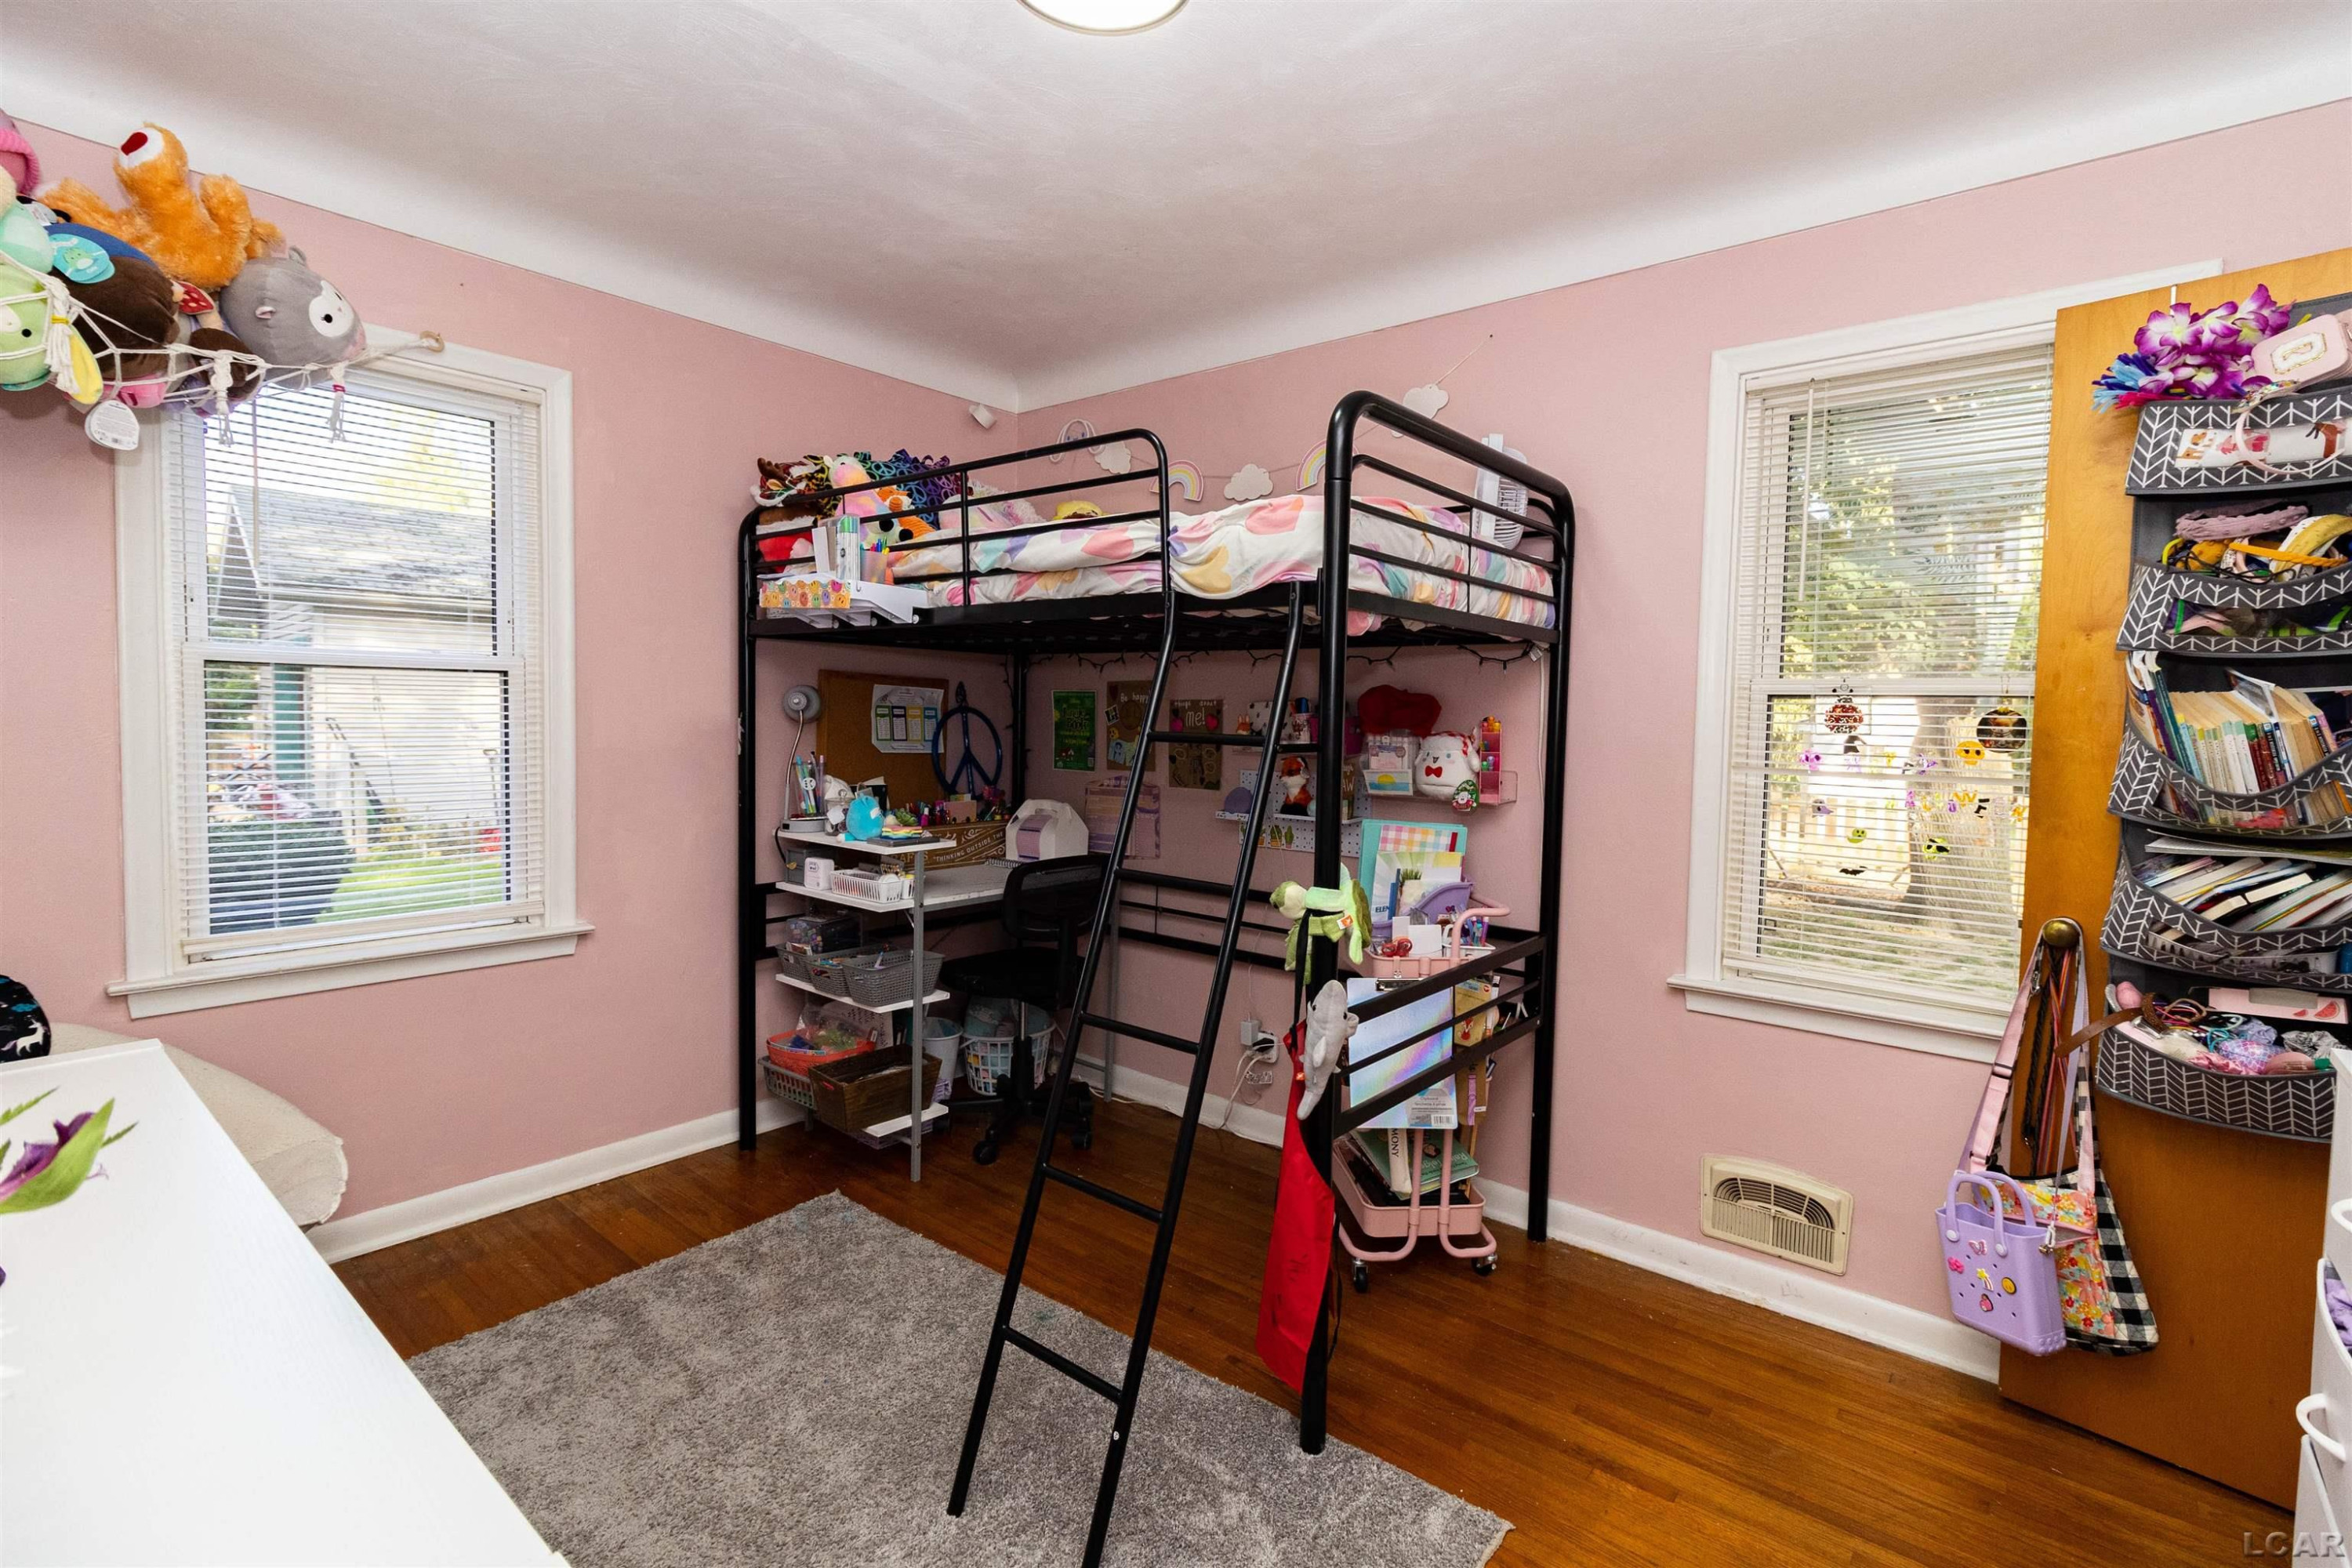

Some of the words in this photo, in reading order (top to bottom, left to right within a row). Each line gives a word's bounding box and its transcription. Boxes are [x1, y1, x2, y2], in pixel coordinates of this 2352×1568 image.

[1185, 707, 1205, 726] me!
[967, 837, 991, 853] OUTSIDE
[993, 832, 1004, 843] THE
